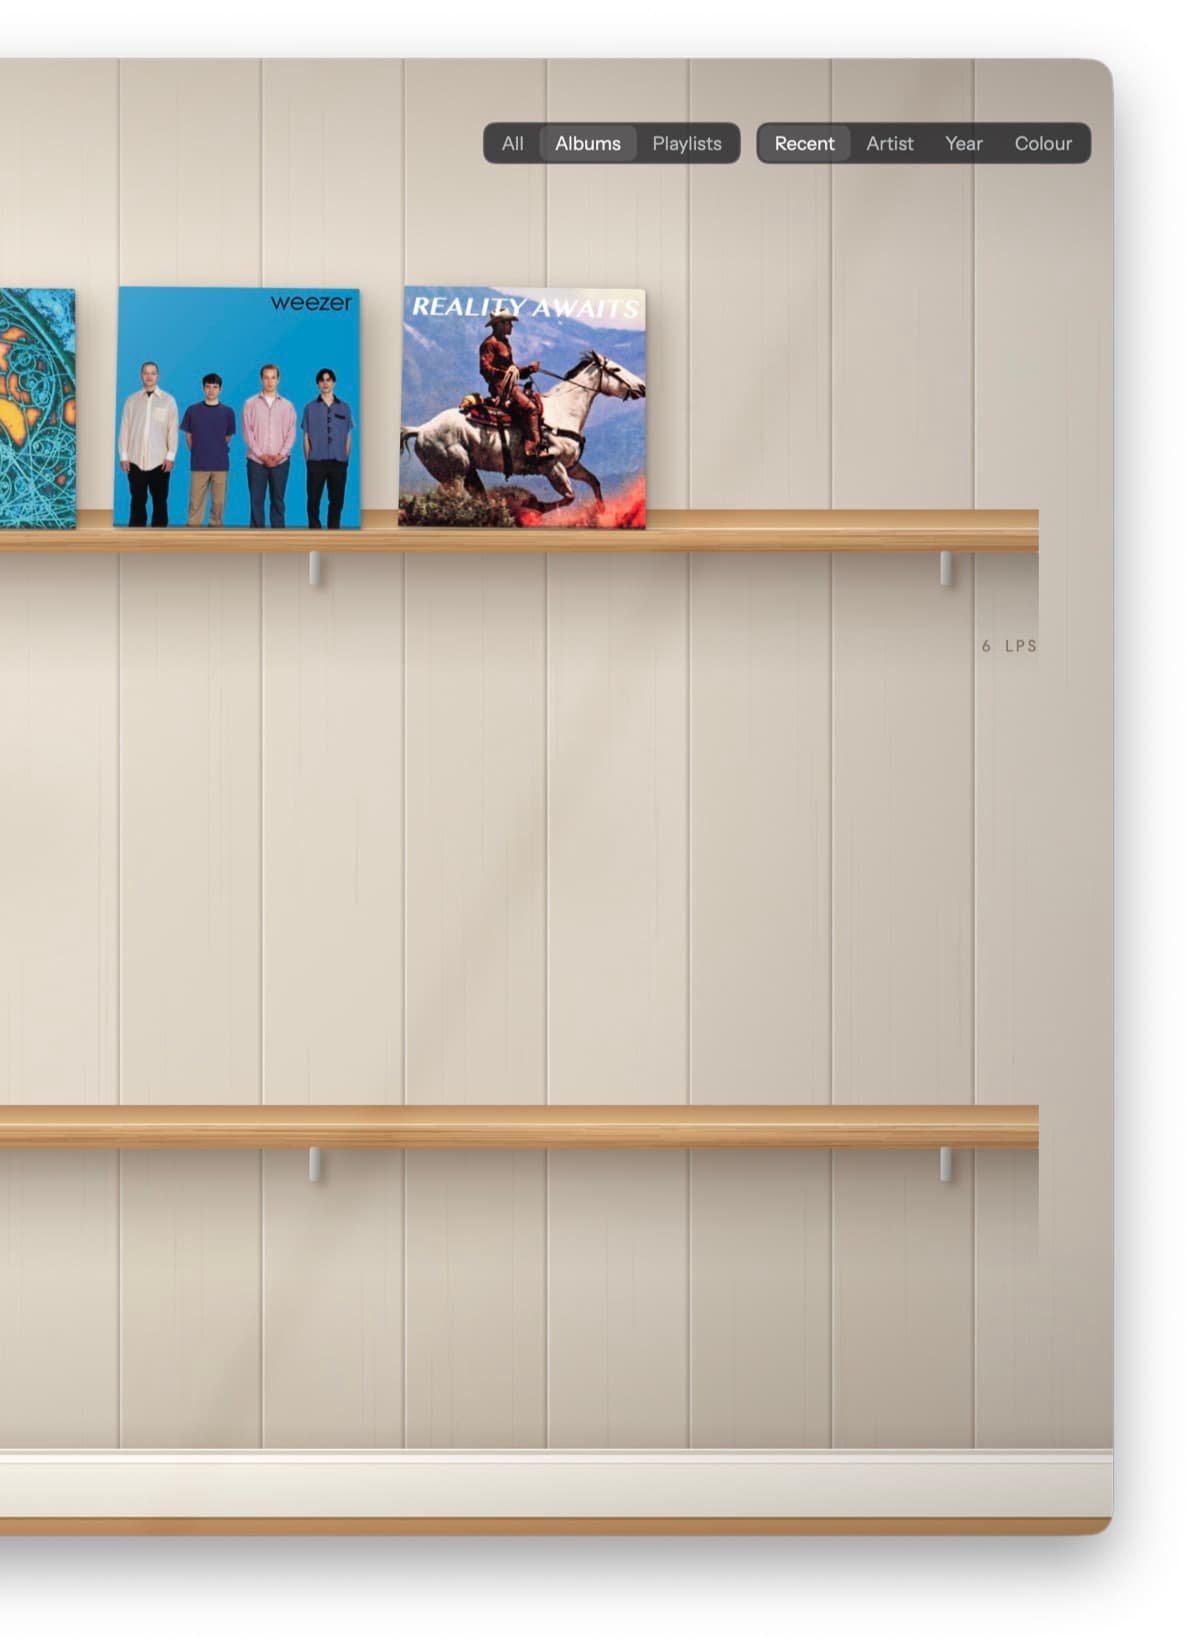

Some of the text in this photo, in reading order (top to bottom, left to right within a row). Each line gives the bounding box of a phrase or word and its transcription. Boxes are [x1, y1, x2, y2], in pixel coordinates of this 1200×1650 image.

[502, 135, 524, 152] All
[555, 135, 621, 152] Albums
[652, 135, 722, 155] Playlists
[775, 135, 836, 152] Recent
[866, 135, 915, 152] Artist
[944, 135, 983, 152] Year
[1014, 135, 1073, 152] Colour
[270, 295, 353, 311] weezer
[411, 296, 640, 319] REALITY AWAITS
[982, 639, 1037, 652] 6 LPS
